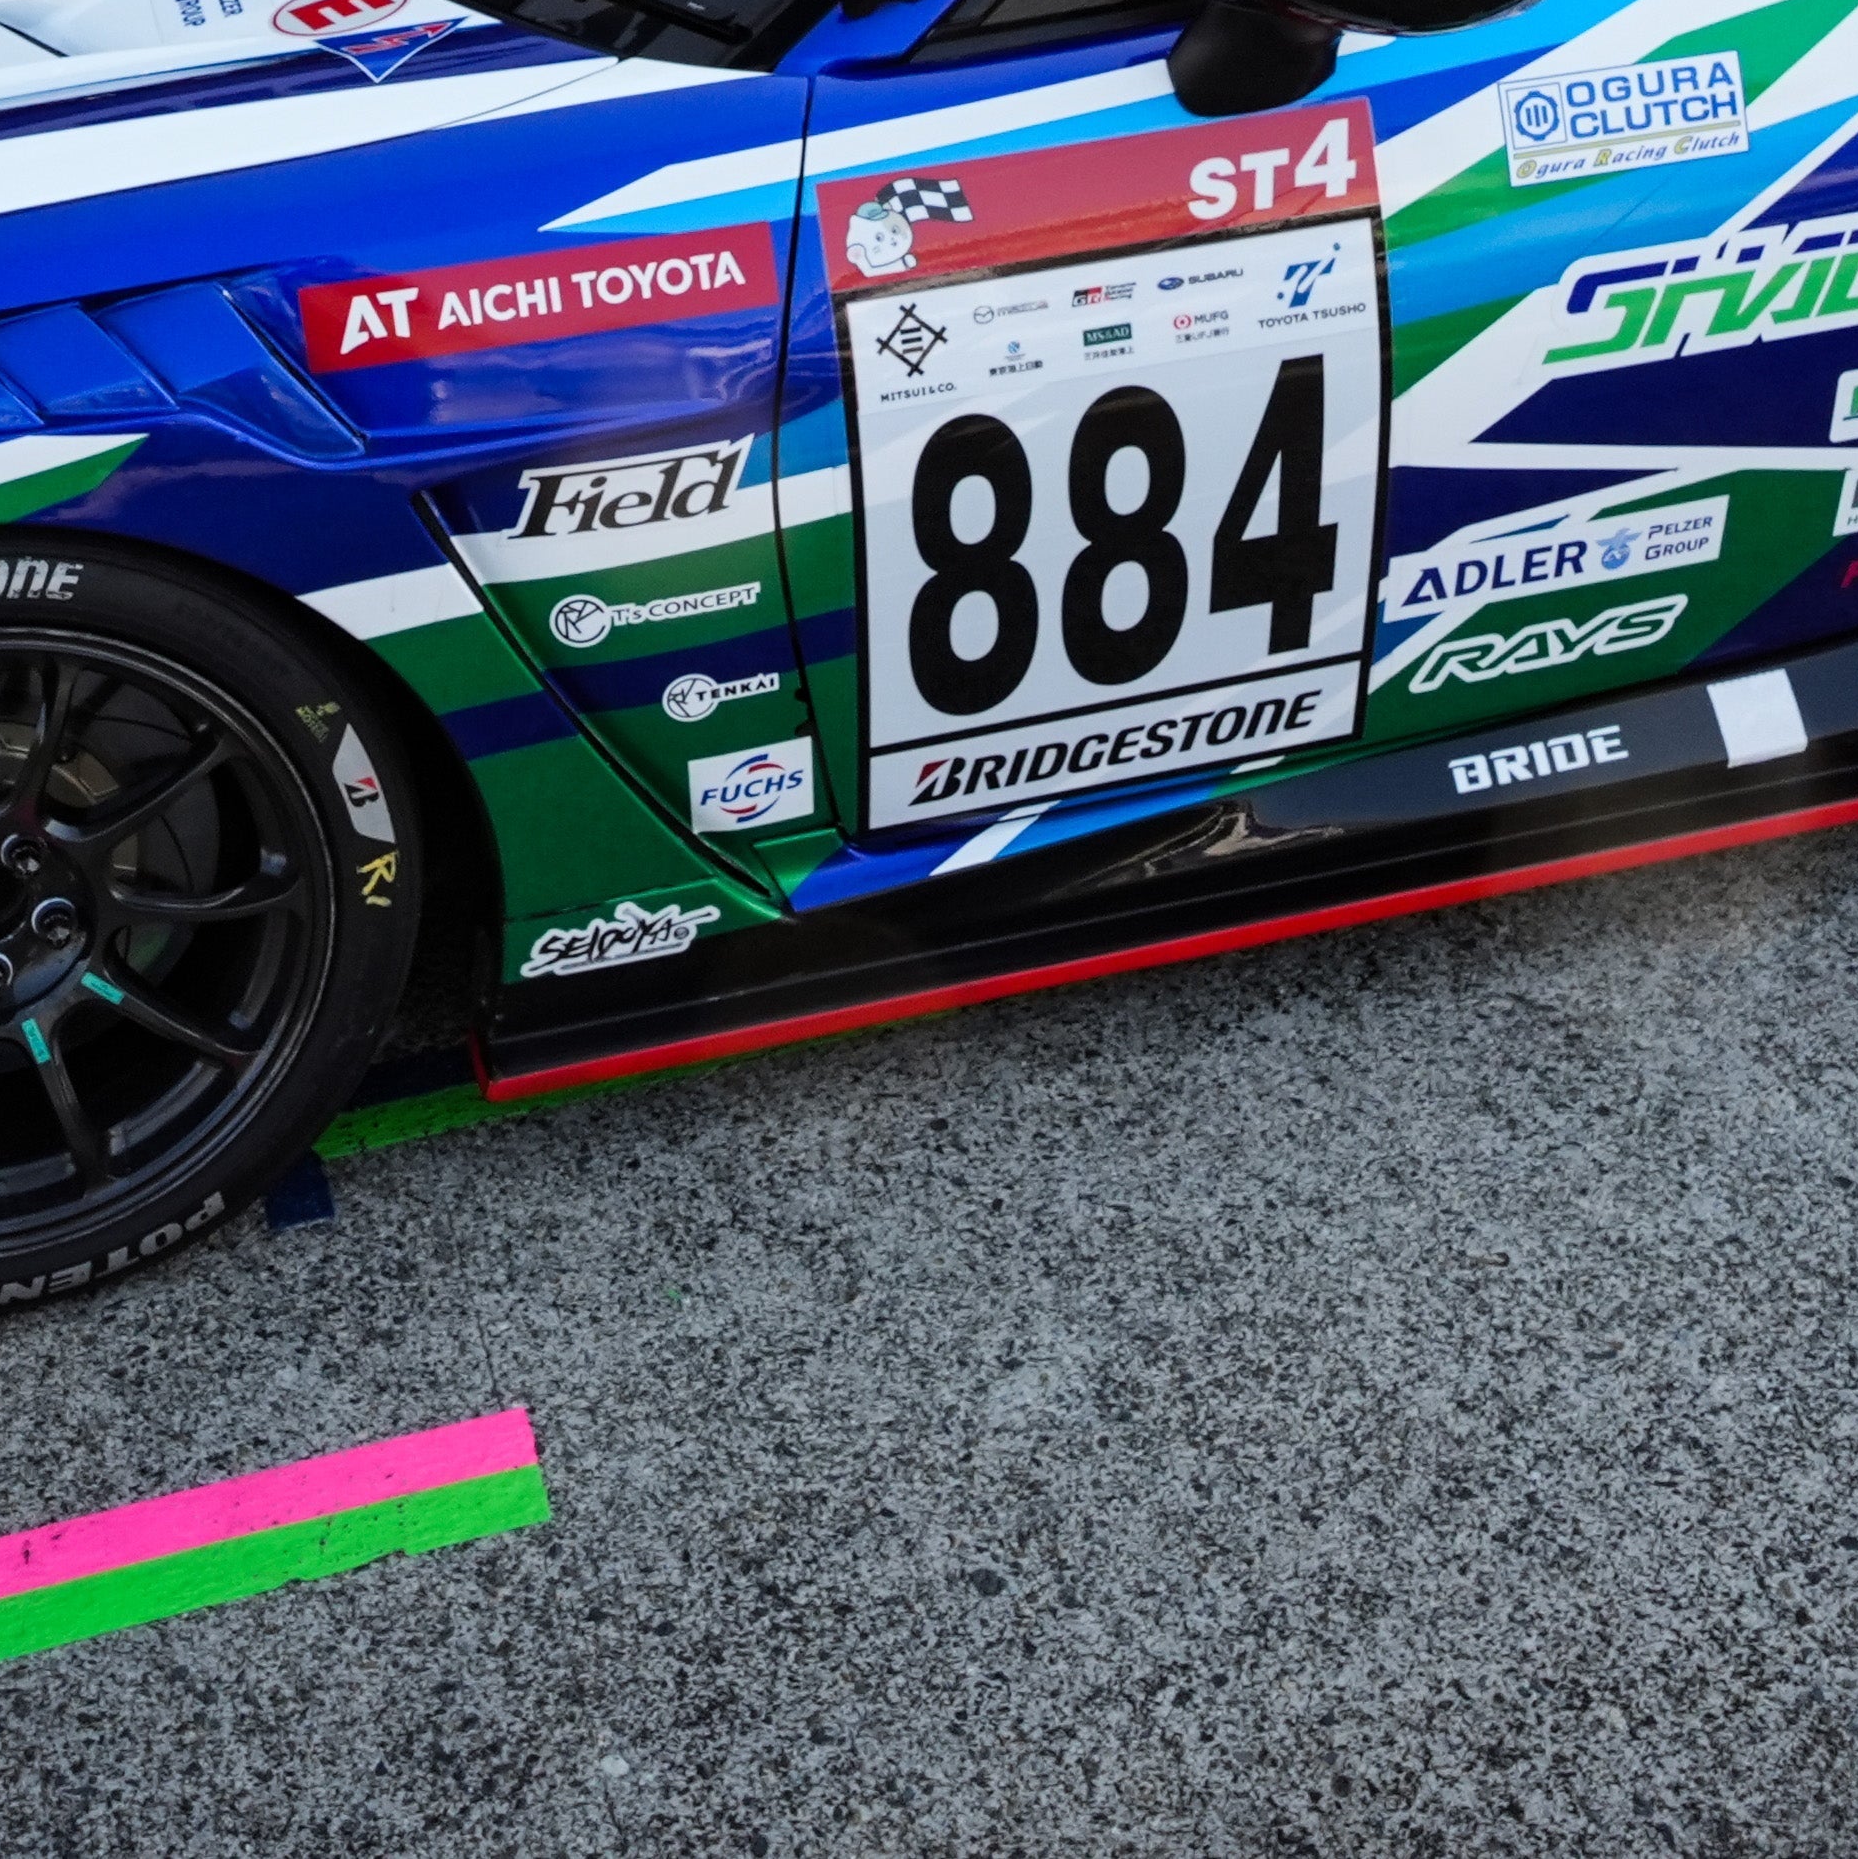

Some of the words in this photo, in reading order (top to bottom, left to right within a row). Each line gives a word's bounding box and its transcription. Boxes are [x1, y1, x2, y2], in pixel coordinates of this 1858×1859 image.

[1566, 61, 1735, 108] OGURA
[1570, 92, 1738, 138] CLUTCH
[1188, 117, 1357, 221] ST4
[1515, 155, 1585, 180] Ogura
[1593, 142, 1668, 168] Racing
[1673, 132, 1740, 156] Clutch
[1187, 268, 1244, 286] SUBARU
[341, 287, 419, 355] AT
[438, 276, 563, 330] AICHI
[571, 251, 746, 310] TOYOTA
[1193, 310, 1229, 326] MUFG
[1258, 310, 1310, 330] TOYOTA
[1313, 303, 1367, 323] TSUSHO
[516, 448, 746, 540] Field
[908, 352, 1340, 716] 884
[1644, 538, 1710, 560] GROUP
[1647, 516, 1713, 539] PELZER
[1401, 538, 1587, 606] ADLER
[613, 606, 642, 623] T's
[648, 586, 756, 616] CONCEPT
[1409, 594, 1689, 693] RAYS
[696, 677, 776, 702] TENKAI
[908, 690, 1321, 806] BRIDGESTONE
[1448, 726, 1629, 794] BRIDE
[701, 770, 803, 806] FUCHS
